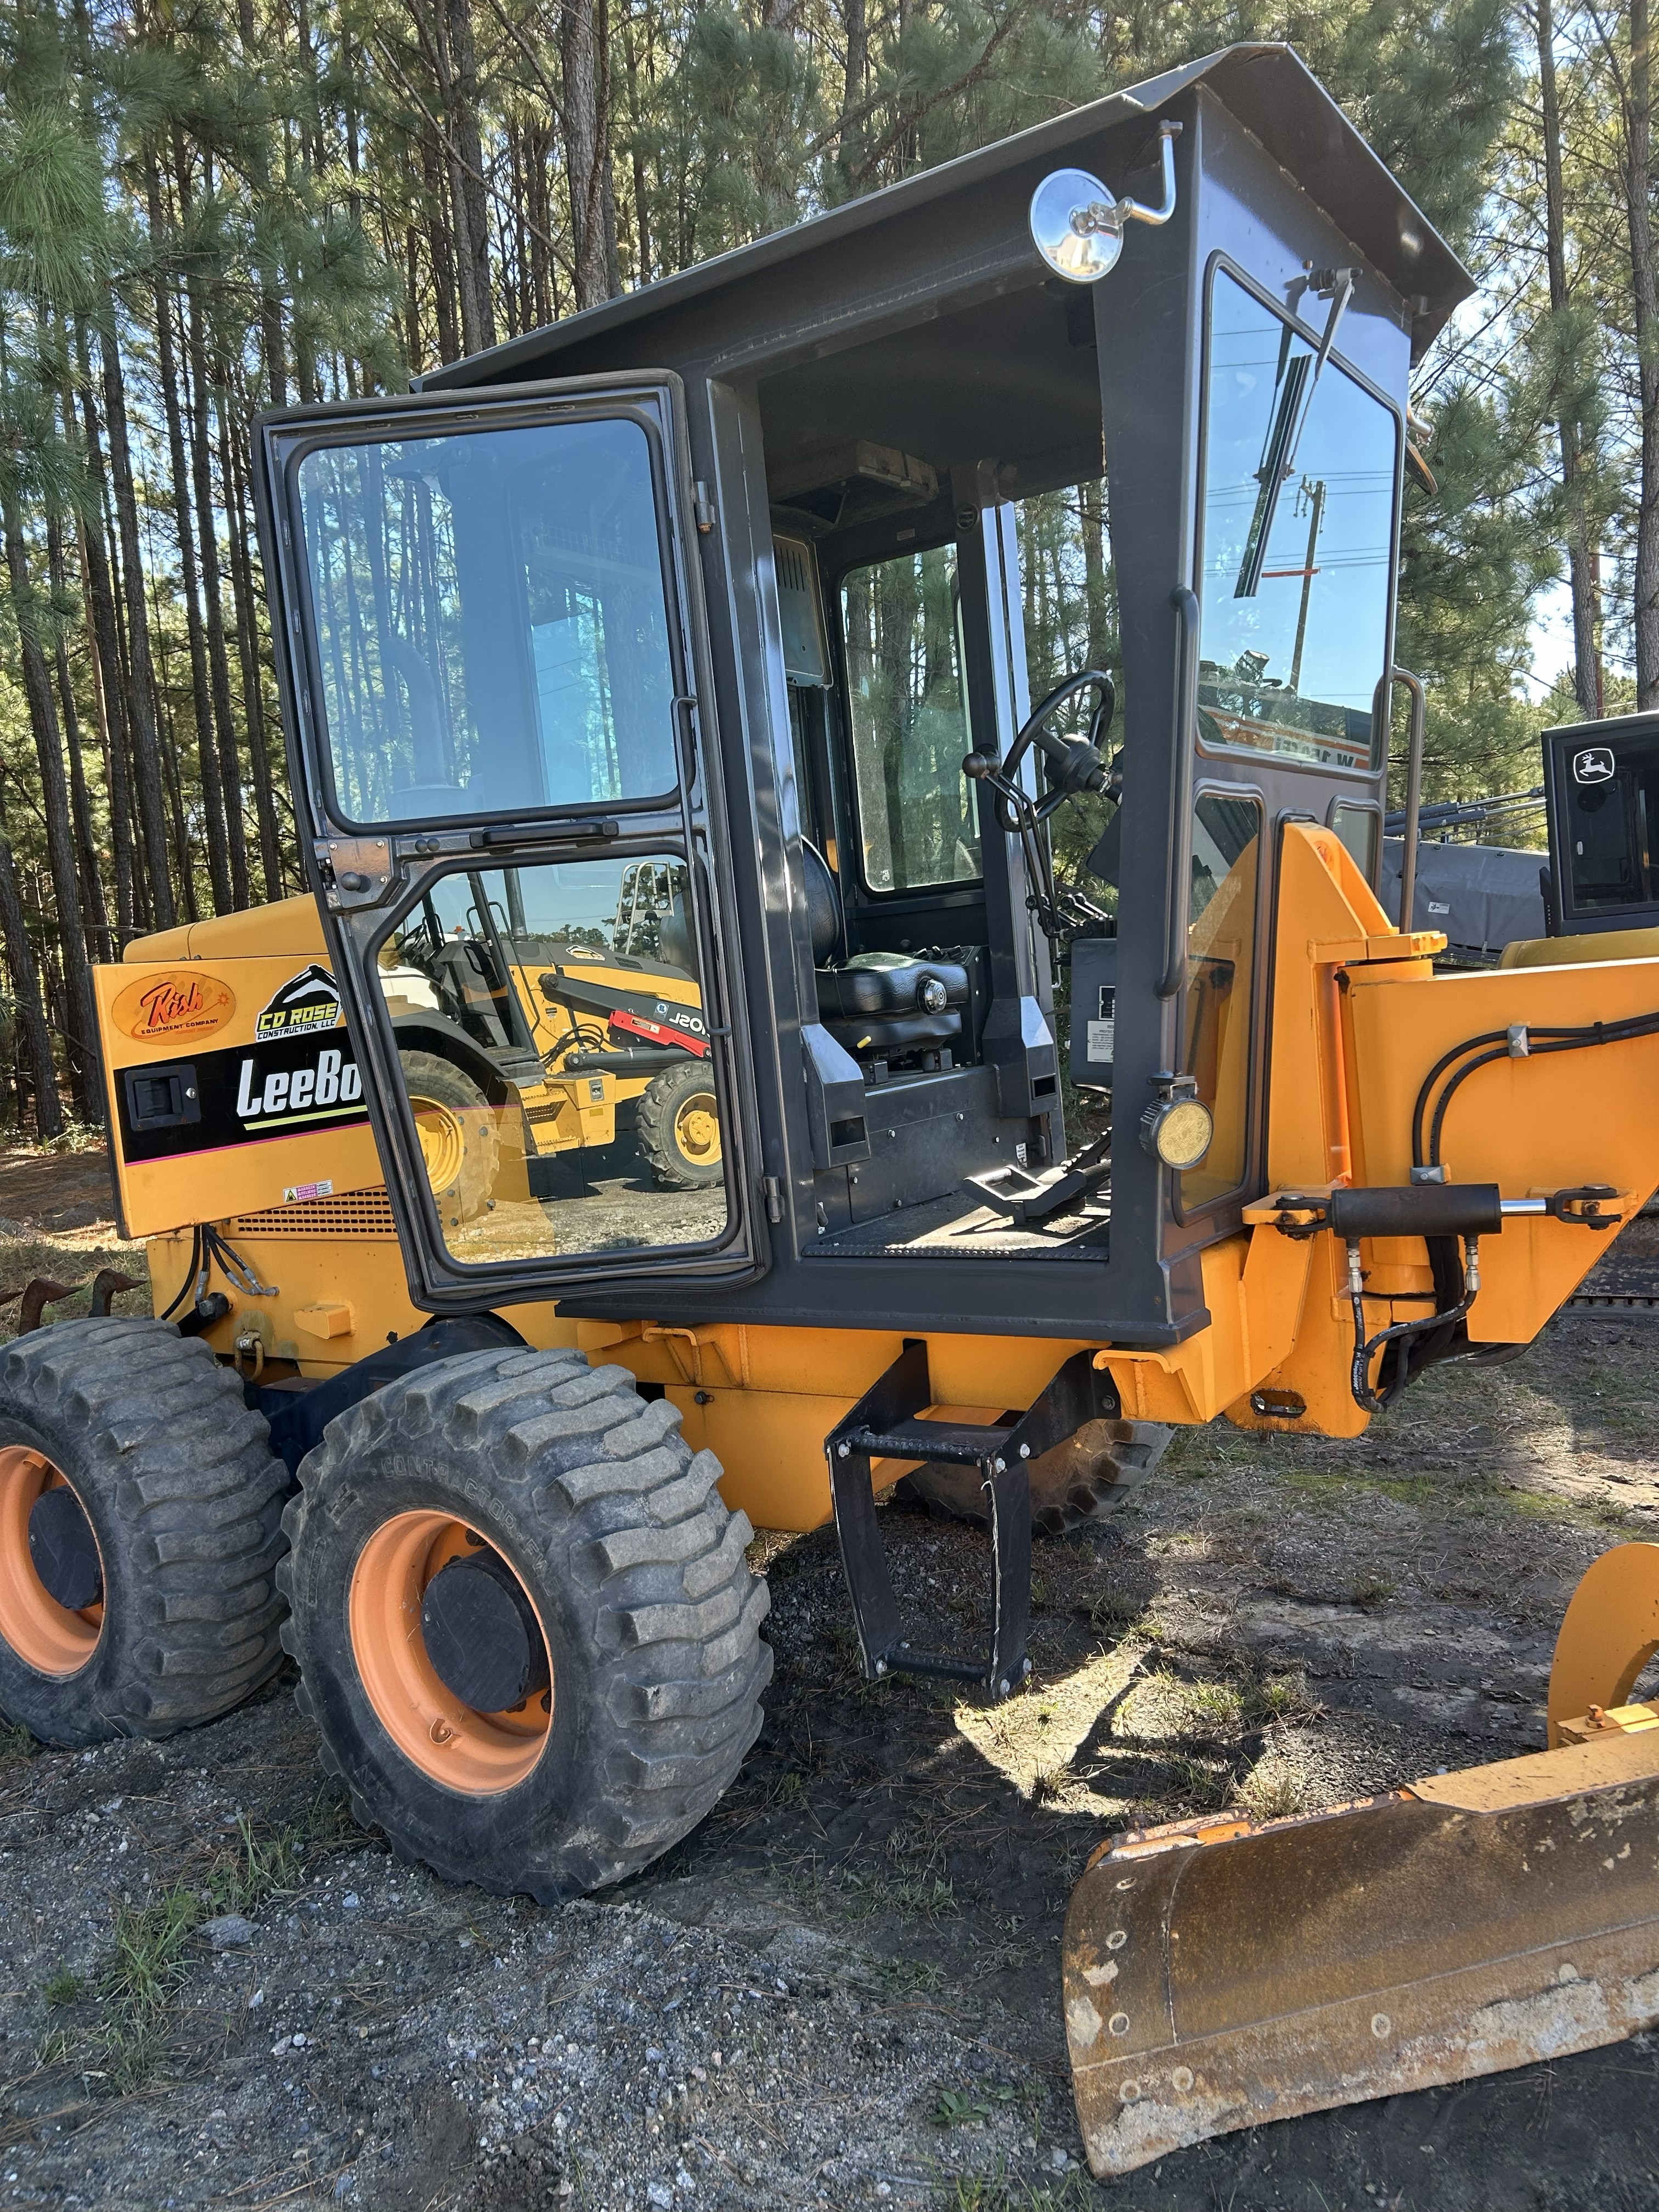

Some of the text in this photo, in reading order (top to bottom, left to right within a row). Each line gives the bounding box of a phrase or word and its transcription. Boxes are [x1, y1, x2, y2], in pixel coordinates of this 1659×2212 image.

[140, 981, 204, 1028] Rish
[259, 1002, 338, 1030] CD ROSE
[141, 1018, 219, 1035] EQUIPMENT COMPANY
[257, 1019, 336, 1040] CONSTRUCTION, LLC
